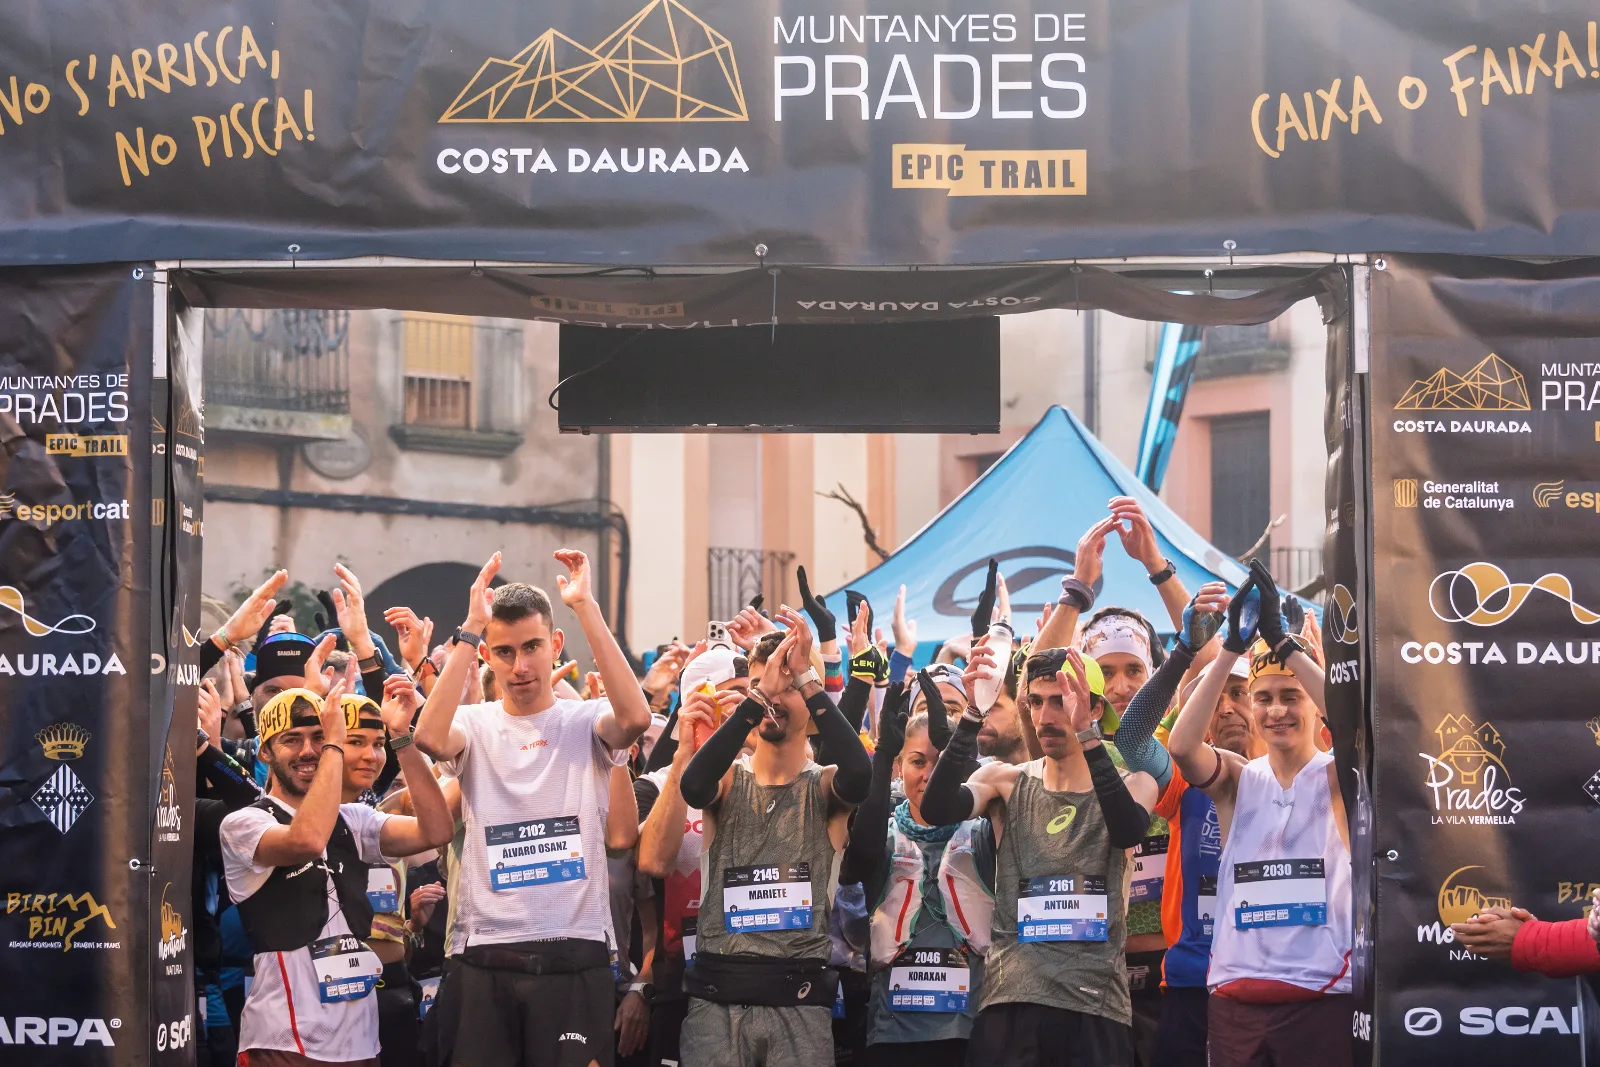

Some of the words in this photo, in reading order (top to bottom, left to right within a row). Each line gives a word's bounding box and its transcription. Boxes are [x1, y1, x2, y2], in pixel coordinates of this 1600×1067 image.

[773, 13, 1018, 44] MUNTANYES
[1034, 13, 1087, 42] DE
[0, 75, 51, 136] NO
[65, 25, 280, 117] S'ARRISCA,
[773, 52, 1088, 122] PRADES
[1250, 75, 1383, 158] CAIXA
[1442, 21, 1600, 117] FAIXA!
[115, 127, 178, 187] NO
[191, 88, 316, 167] PISCA!
[436, 147, 558, 174] COSTA
[567, 146, 751, 174] DAURADA
[900, 154, 965, 182] EPIC
[979, 159, 1077, 189] TRAIL
[796, 300, 940, 312] DAURADA
[947, 296, 1042, 309] COSTA
[106, 373, 129, 388] DE
[0, 391, 129, 424] PRADES
[1393, 419, 1447, 434] COSTA
[1450, 420, 1533, 435] DAURADA
[49, 438, 78, 451] EPIC
[83, 439, 123, 454] TRAIL
[1423, 480, 1499, 494] Generalitat
[1423, 496, 1442, 509] de
[1444, 496, 1515, 512] Catalunya
[16, 499, 130, 526] esportcat
[1400, 641, 1509, 665] COSTA
[852, 659, 875, 669] LEKI
[1418, 752, 1528, 815] Prades
[1431, 815, 1444, 825] LA
[1445, 815, 1468, 825] VILA
[1467, 815, 1517, 825] VERMELLA
[518, 823, 547, 839] 2102
[502, 843, 537, 859] ÁLVARO
[538, 840, 568, 854] OSANZ
[752, 867, 780, 882] 2145
[1262, 863, 1292, 878] 2030
[1049, 879, 1074, 892] 2161
[749, 888, 788, 901] MARIETE
[1043, 899, 1080, 911] ANTUAN
[103, 941, 121, 949] PRADES
[914, 951, 941, 964] 2046
[908, 971, 947, 982] KORAXAN
[1459, 1006, 1579, 1035] SCA
